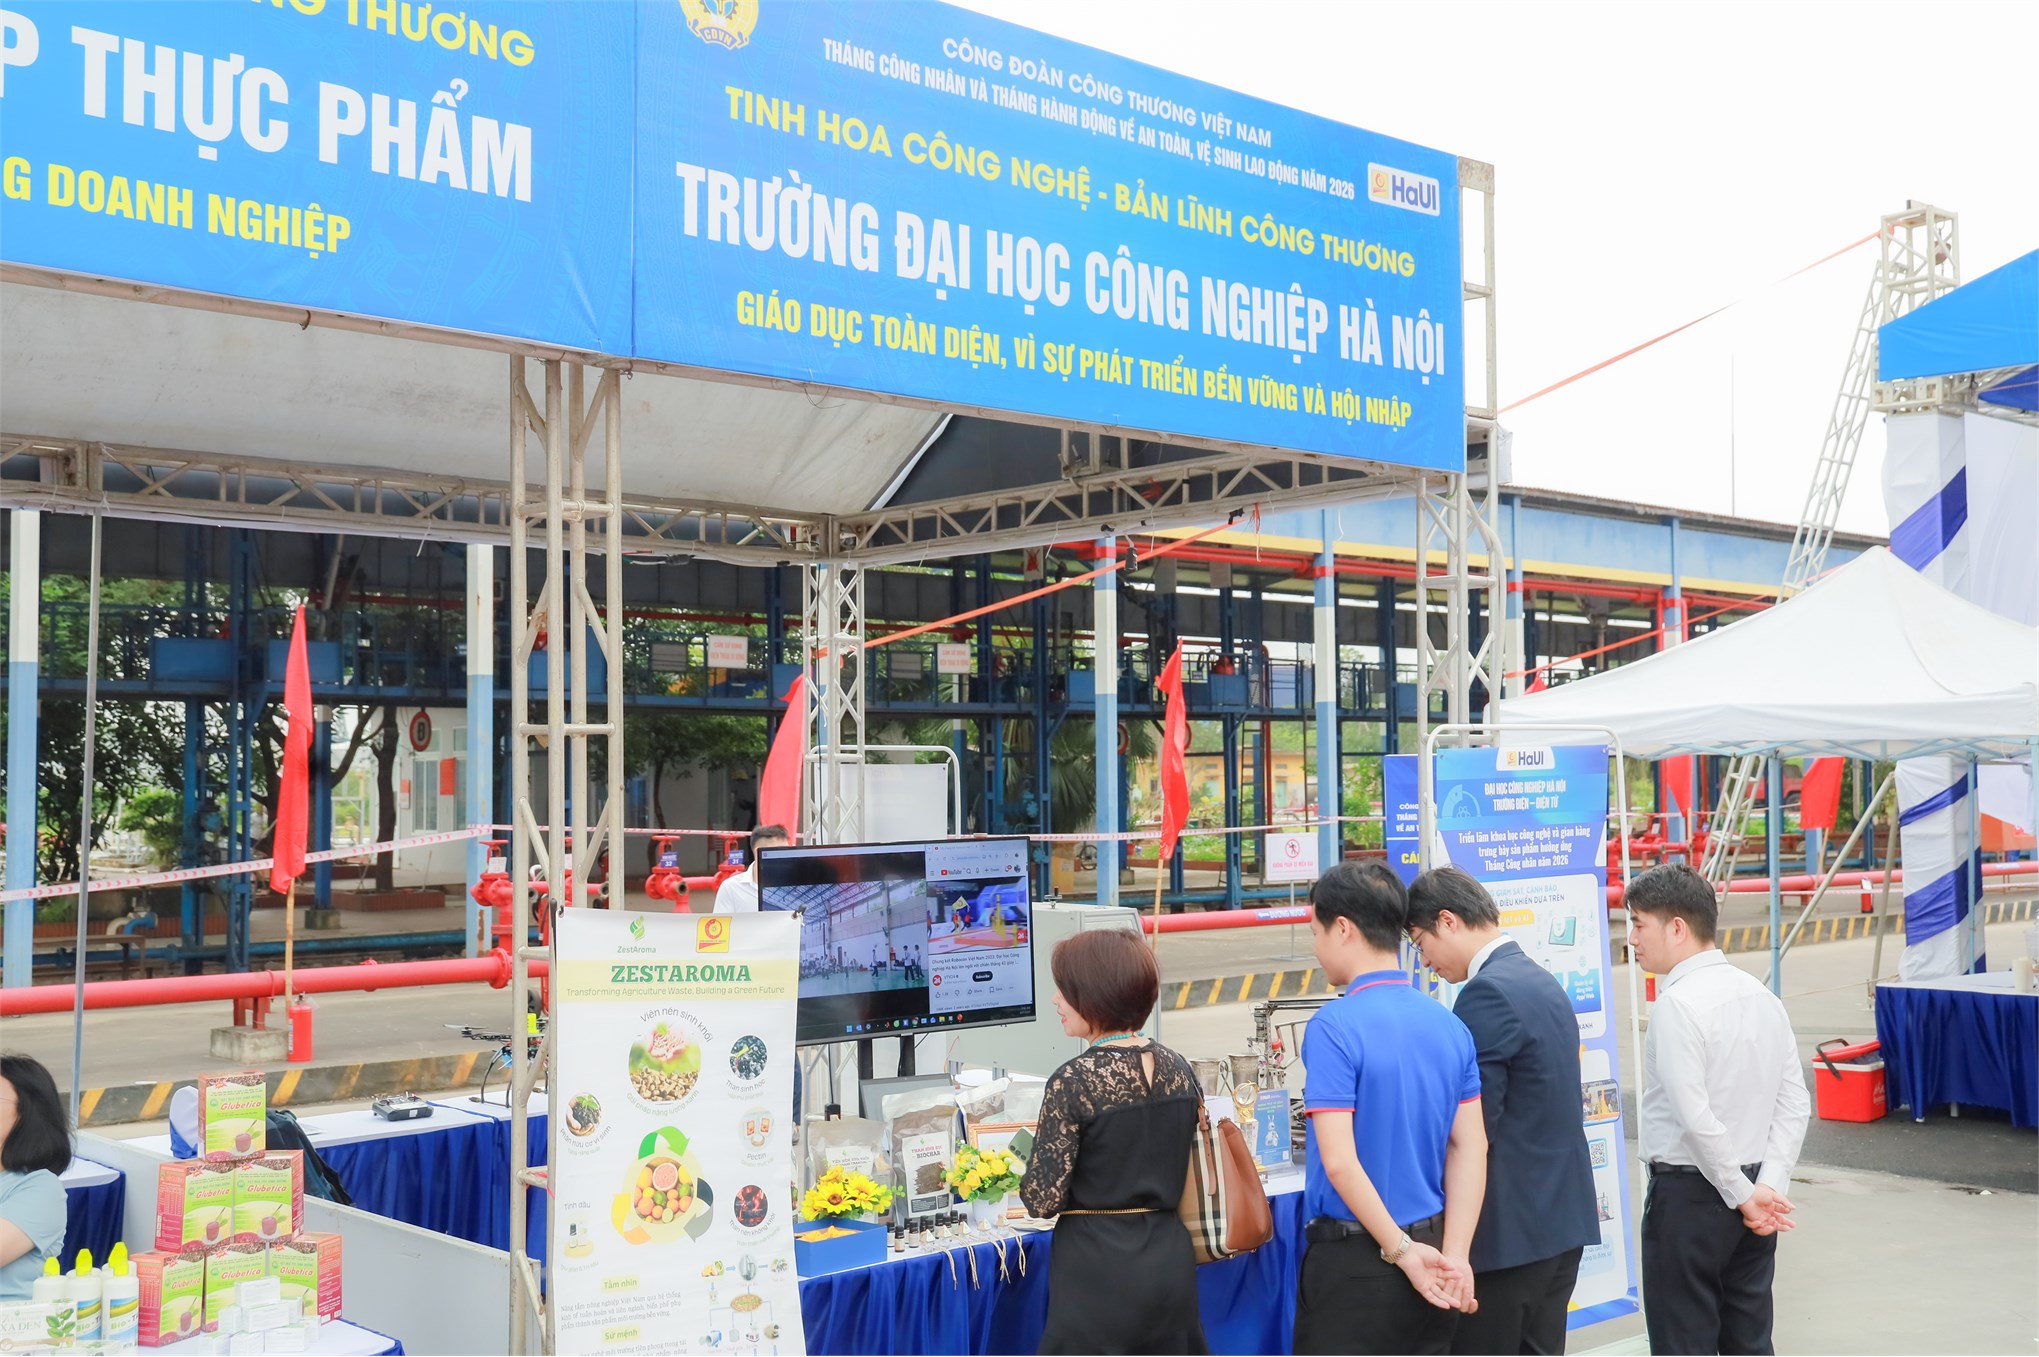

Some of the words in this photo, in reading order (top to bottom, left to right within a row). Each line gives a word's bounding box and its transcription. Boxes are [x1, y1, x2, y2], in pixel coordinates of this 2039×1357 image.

[942, 37, 1003, 71] CÔNG
[1008, 55, 1063, 89] ĐOÀN
[1068, 72, 1123, 105] CÔNG
[1127, 89, 1197, 127] THƯƠNG
[1201, 111, 1233, 139] VIỆT
[1236, 123, 1272, 148] NAM
[71, 25, 289, 161] THỰC
[318, 77, 532, 202] PHẨM
[823, 37, 875, 73] THÁNG
[879, 53, 921, 86] CÔNG
[925, 67, 966, 97] NHÂN
[969, 76, 988, 103] VÀ
[991, 85, 1037, 116] THÁNG
[1041, 98, 1077, 127] HÀNH
[1080, 107, 1117, 137] ĐỘNG
[1119, 116, 1136, 142] VỀ
[1138, 126, 1156, 149] AN
[1158, 130, 1194, 161] TOÀN,
[1196, 140, 1212, 162] VỆ
[1214, 147, 1242, 169] SINH
[1244, 154, 1266, 178] LAO
[1267, 158, 1299, 185] ĐỘNG
[1301, 166, 1327, 193] NĂM
[1329, 177, 1355, 201] 2026
[725, 85, 805, 136] TINH
[818, 109, 893, 158] HOA
[902, 131, 1001, 181] CÔNG
[1011, 157, 1091, 211] NGHỆ
[1115, 178, 1169, 223] BẢN
[1177, 193, 1232, 237] LĨNH
[1240, 213, 1315, 255] CÔNG
[1321, 233, 1415, 278] THƯƠNG
[48, 163, 194, 229] DOANH
[208, 197, 351, 259] NGHIỆP
[676, 160, 879, 273] TRƯỜNG
[894, 210, 971, 300] ĐẠI
[986, 229, 1071, 316] HỌC
[1085, 245, 1189, 331] CÔNG
[1202, 275, 1328, 364] NGHIỆP
[1339, 297, 1383, 366] HÀ
[1392, 308, 1445, 385] NỘI
[737, 289, 801, 333] GIÁO
[810, 304, 863, 348] DỤC
[870, 312, 937, 355] TOÀN
[944, 325, 1007, 370] DIỆN,
[1014, 328, 1036, 370] VÌ
[1043, 340, 1074, 383] SỰ
[1079, 348, 1134, 385] PHÁT
[1139, 354, 1198, 396] TRIỂN
[1203, 363, 1242, 403] BỀN
[1248, 374, 1298, 412] VỮNG
[1303, 383, 1327, 415] VÀ
[1331, 386, 1360, 426] HỘI
[1365, 395, 1411, 432] NHẬP
[1399, 802, 1419, 810] CÔNG
[1396, 812, 1418, 821] THÁNG
[1458, 831, 1475, 844] Triển
[1476, 831, 1489, 842] lãm
[1490, 831, 1506, 842] khoa
[1507, 829, 1518, 843] học
[1519, 829, 1534, 841] công
[1535, 828, 1551, 841] nghệ
[1552, 827, 1559, 838] và
[1560, 827, 1574, 839] gian
[1575, 826, 1591, 838] hàng
[1478, 846, 1497, 858] trưng
[1498, 844, 1510, 857] bày
[1522, 842, 1539, 856] phẩm
[1485, 860, 1505, 873] Tháng
[1505, 859, 1521, 871] Công
[1522, 858, 1537, 869] nhân
[1538, 857, 1551, 867] năm
[1552, 854, 1569, 866] 2026
[617, 945, 657, 954] ZestAroma
[611, 965, 752, 983] ZESTAROMA
[567, 988, 620, 997] Transforming
[622, 987, 667, 996] Agriculture
[696, 986, 726, 995] Building
[734, 986, 758, 994] Green
[759, 986, 785, 994] Future
[680, 1010, 698, 1025] sinh
[916, 1151, 941, 1159] BIOCHAR
[247, 1185, 287, 1193] Glubetica
[221, 1269, 261, 1280] Glubetica
